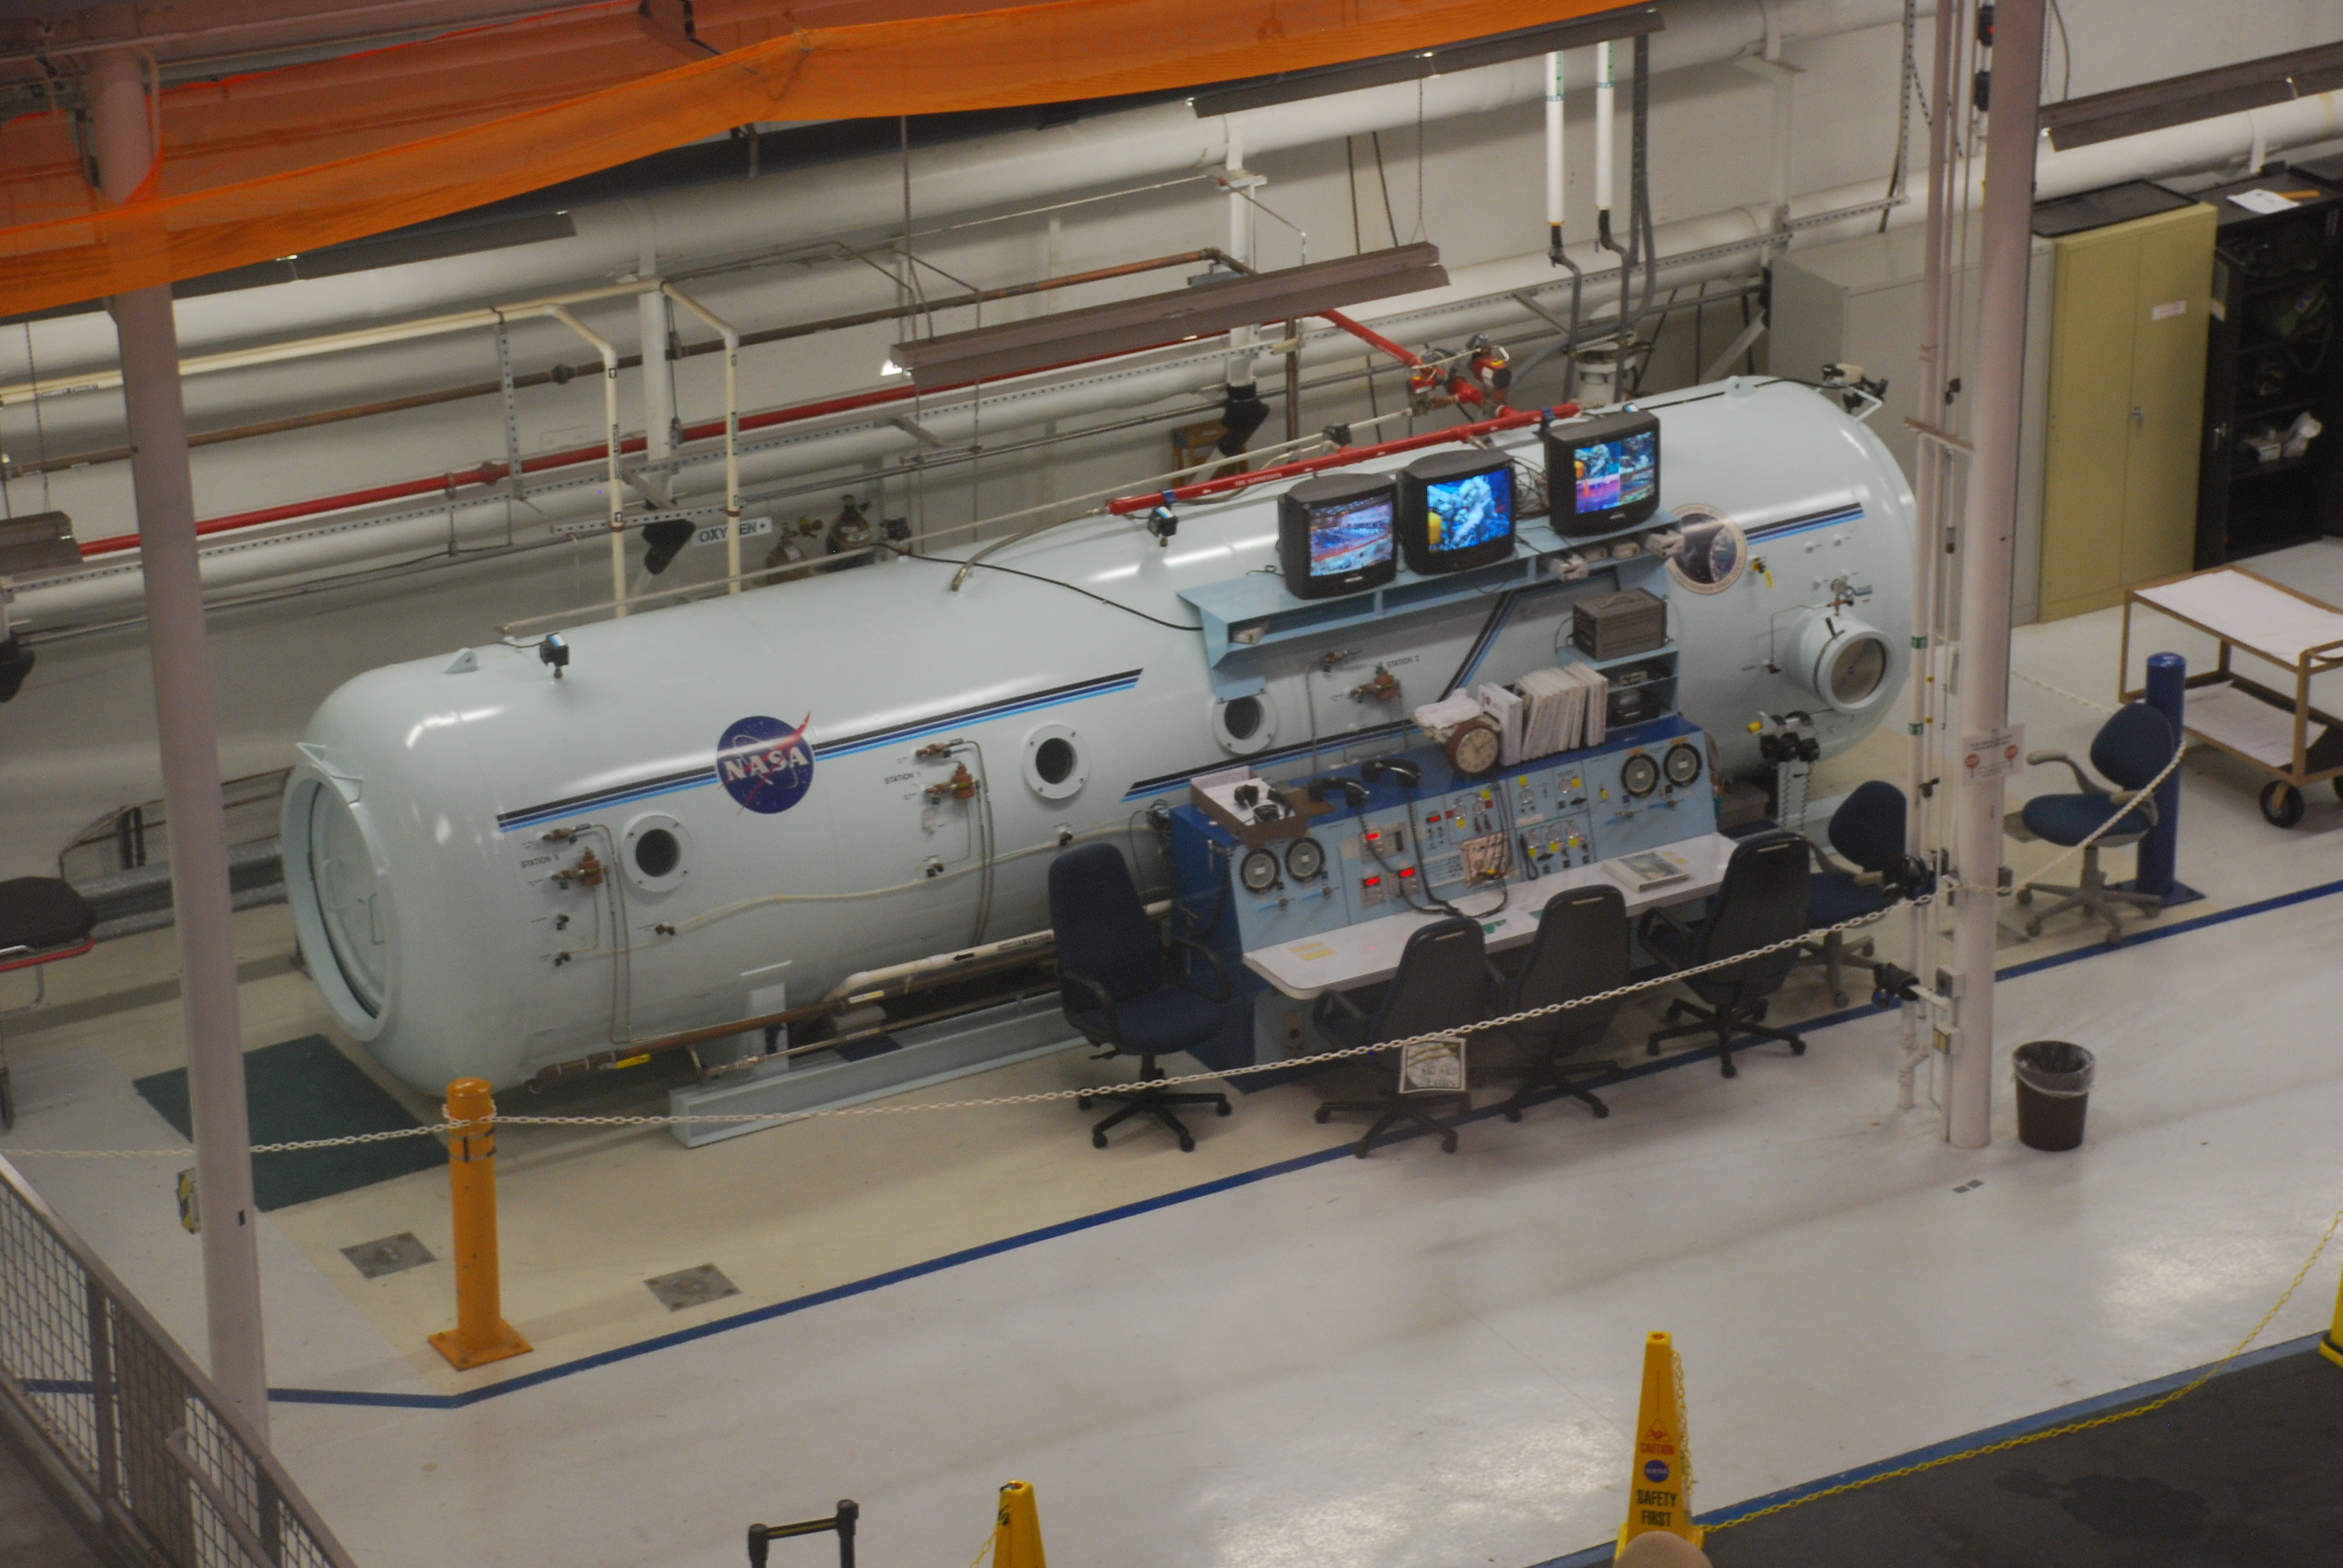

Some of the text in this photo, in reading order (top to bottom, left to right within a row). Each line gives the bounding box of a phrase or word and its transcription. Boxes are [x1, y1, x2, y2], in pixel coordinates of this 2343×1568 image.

[700, 521, 756, 542] OXYEN
[724, 746, 808, 780] NASA
[885, 772, 914, 784] STATION
[521, 855, 551, 868] STATION
[1638, 1489, 1677, 1507] SAFETY
[1641, 1510, 1671, 1526] FIRST
